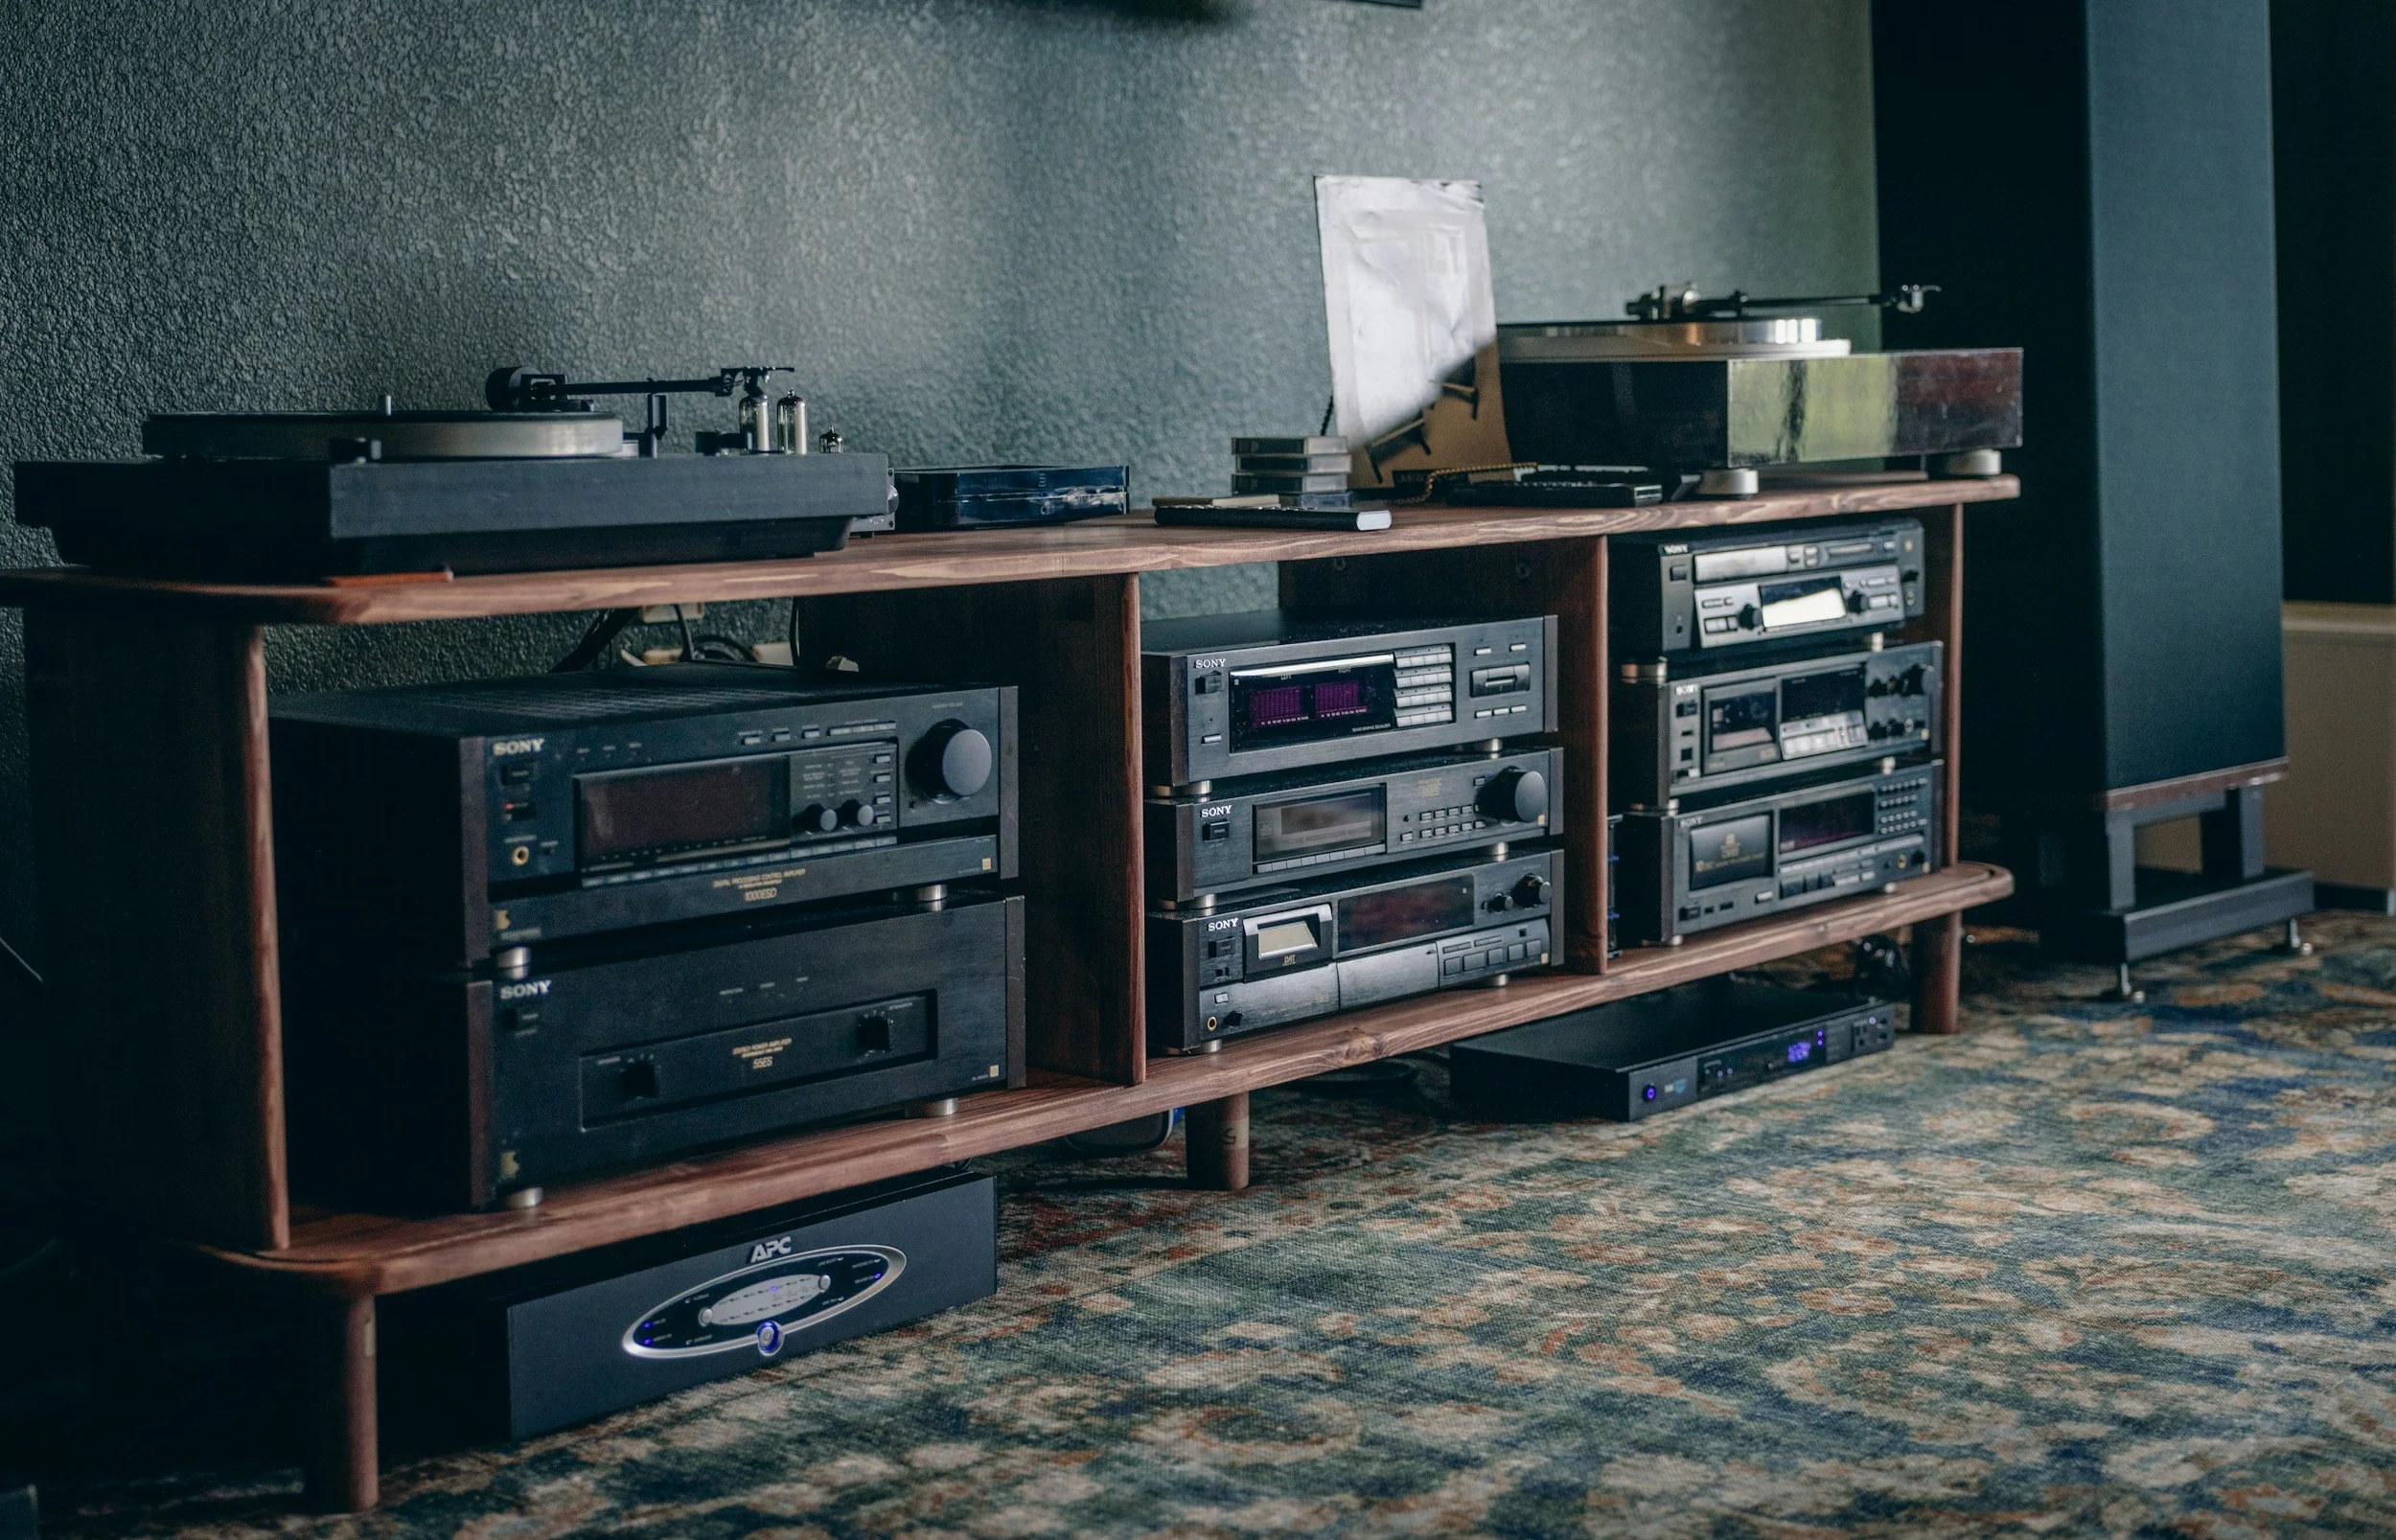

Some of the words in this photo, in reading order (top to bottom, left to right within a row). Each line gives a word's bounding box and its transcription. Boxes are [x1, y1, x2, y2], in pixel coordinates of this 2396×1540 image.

[1195, 658, 1227, 669] SONY
[493, 738, 545, 756] SONY
[1200, 805, 1233, 818] SONY
[1207, 918, 1239, 931] SONY
[500, 979, 552, 1000] SONY
[750, 1235, 792, 1263] APC
